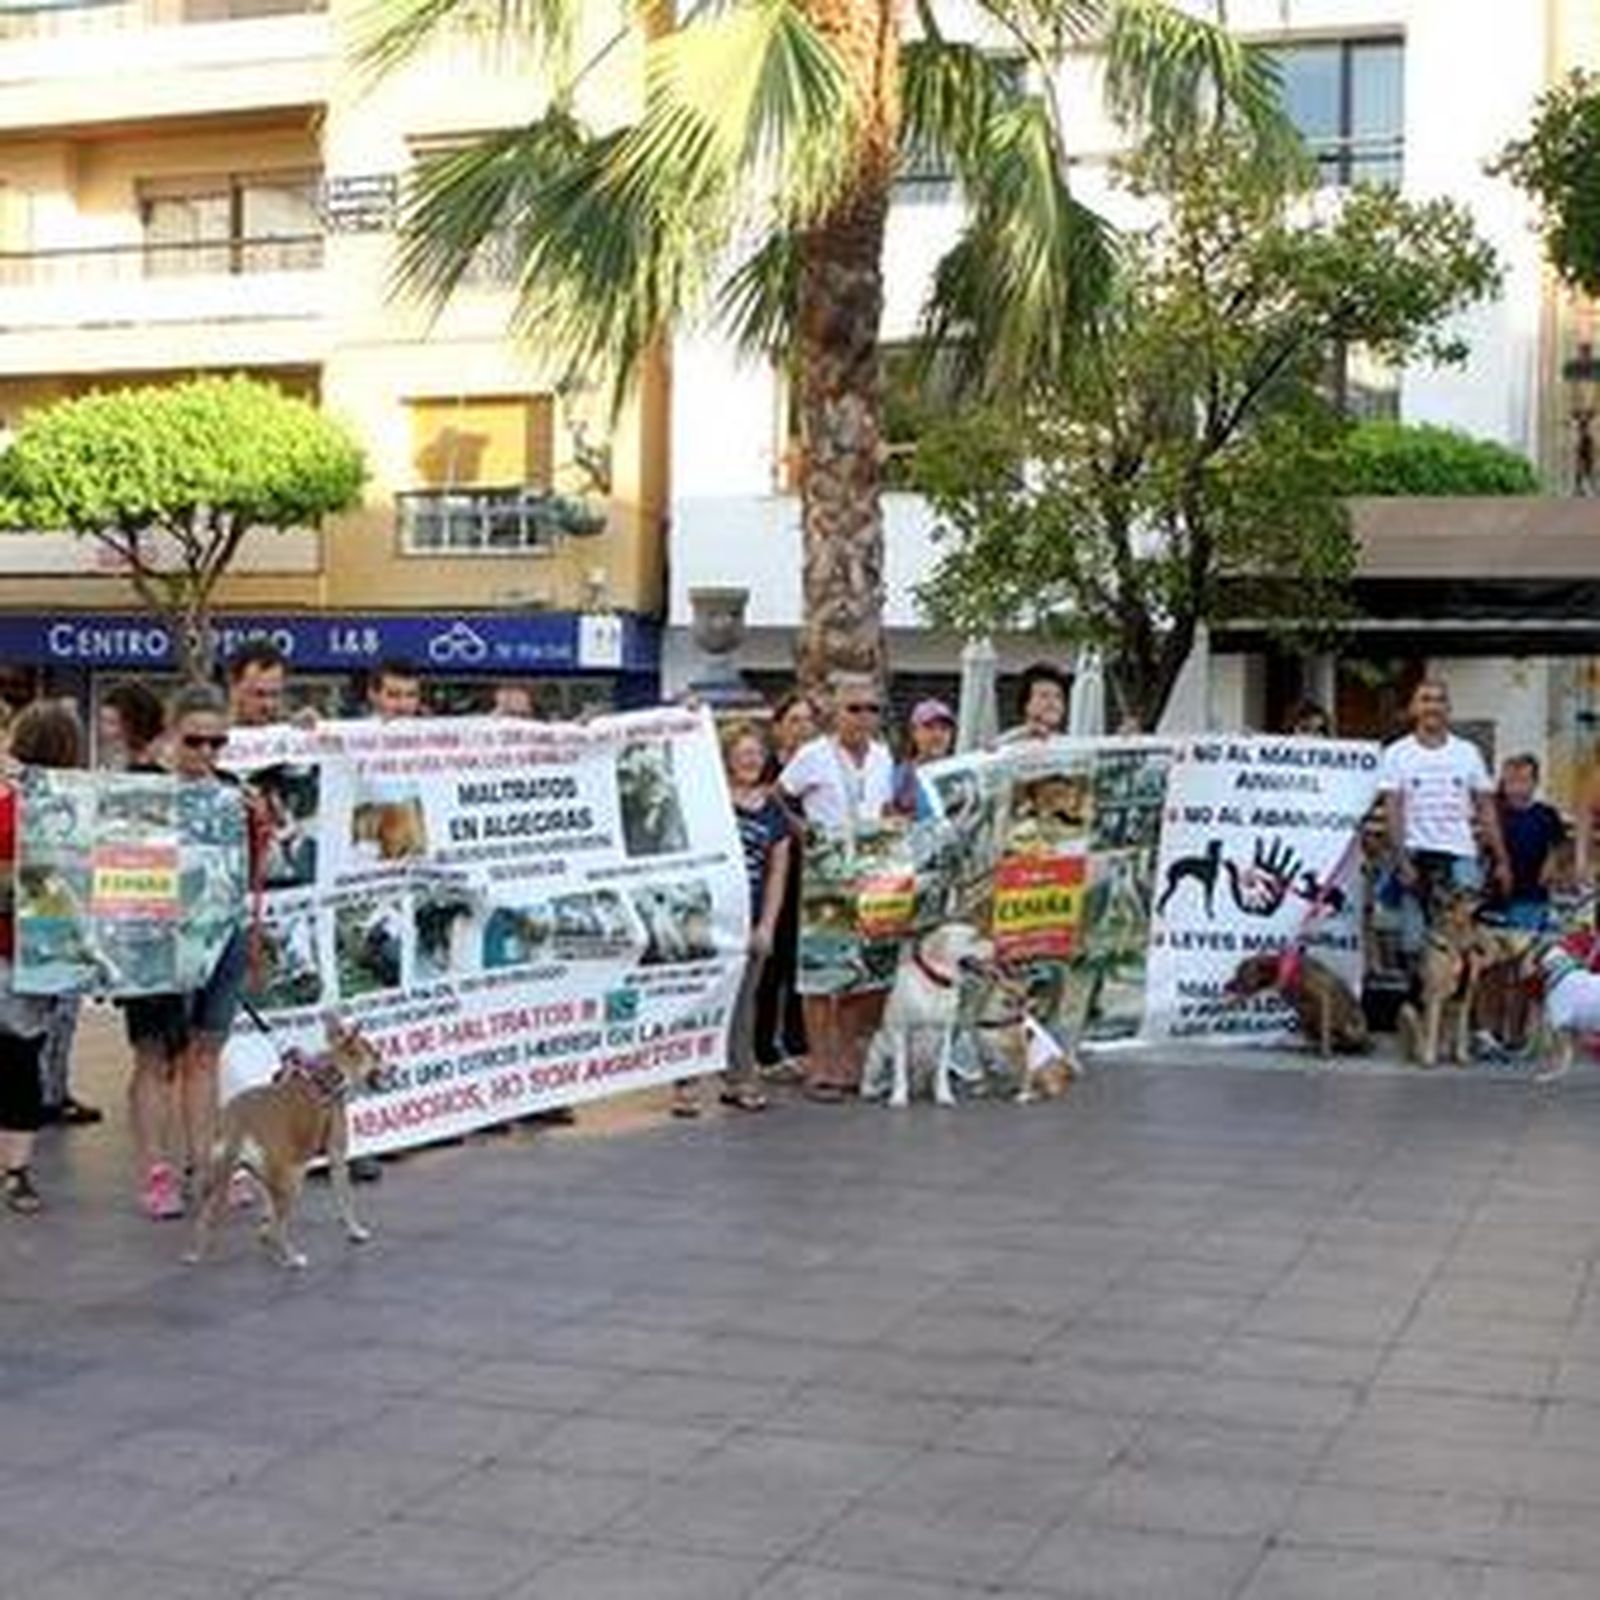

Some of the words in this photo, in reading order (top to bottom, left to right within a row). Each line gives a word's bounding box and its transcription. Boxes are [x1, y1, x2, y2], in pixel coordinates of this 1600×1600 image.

[49, 624, 169, 656] CENTRO
[1259, 746, 1377, 770] MALTRATO
[457, 777, 578, 804] MALTRATOS
[449, 815, 478, 841] EN
[483, 807, 594, 838] ALGECIRAS
